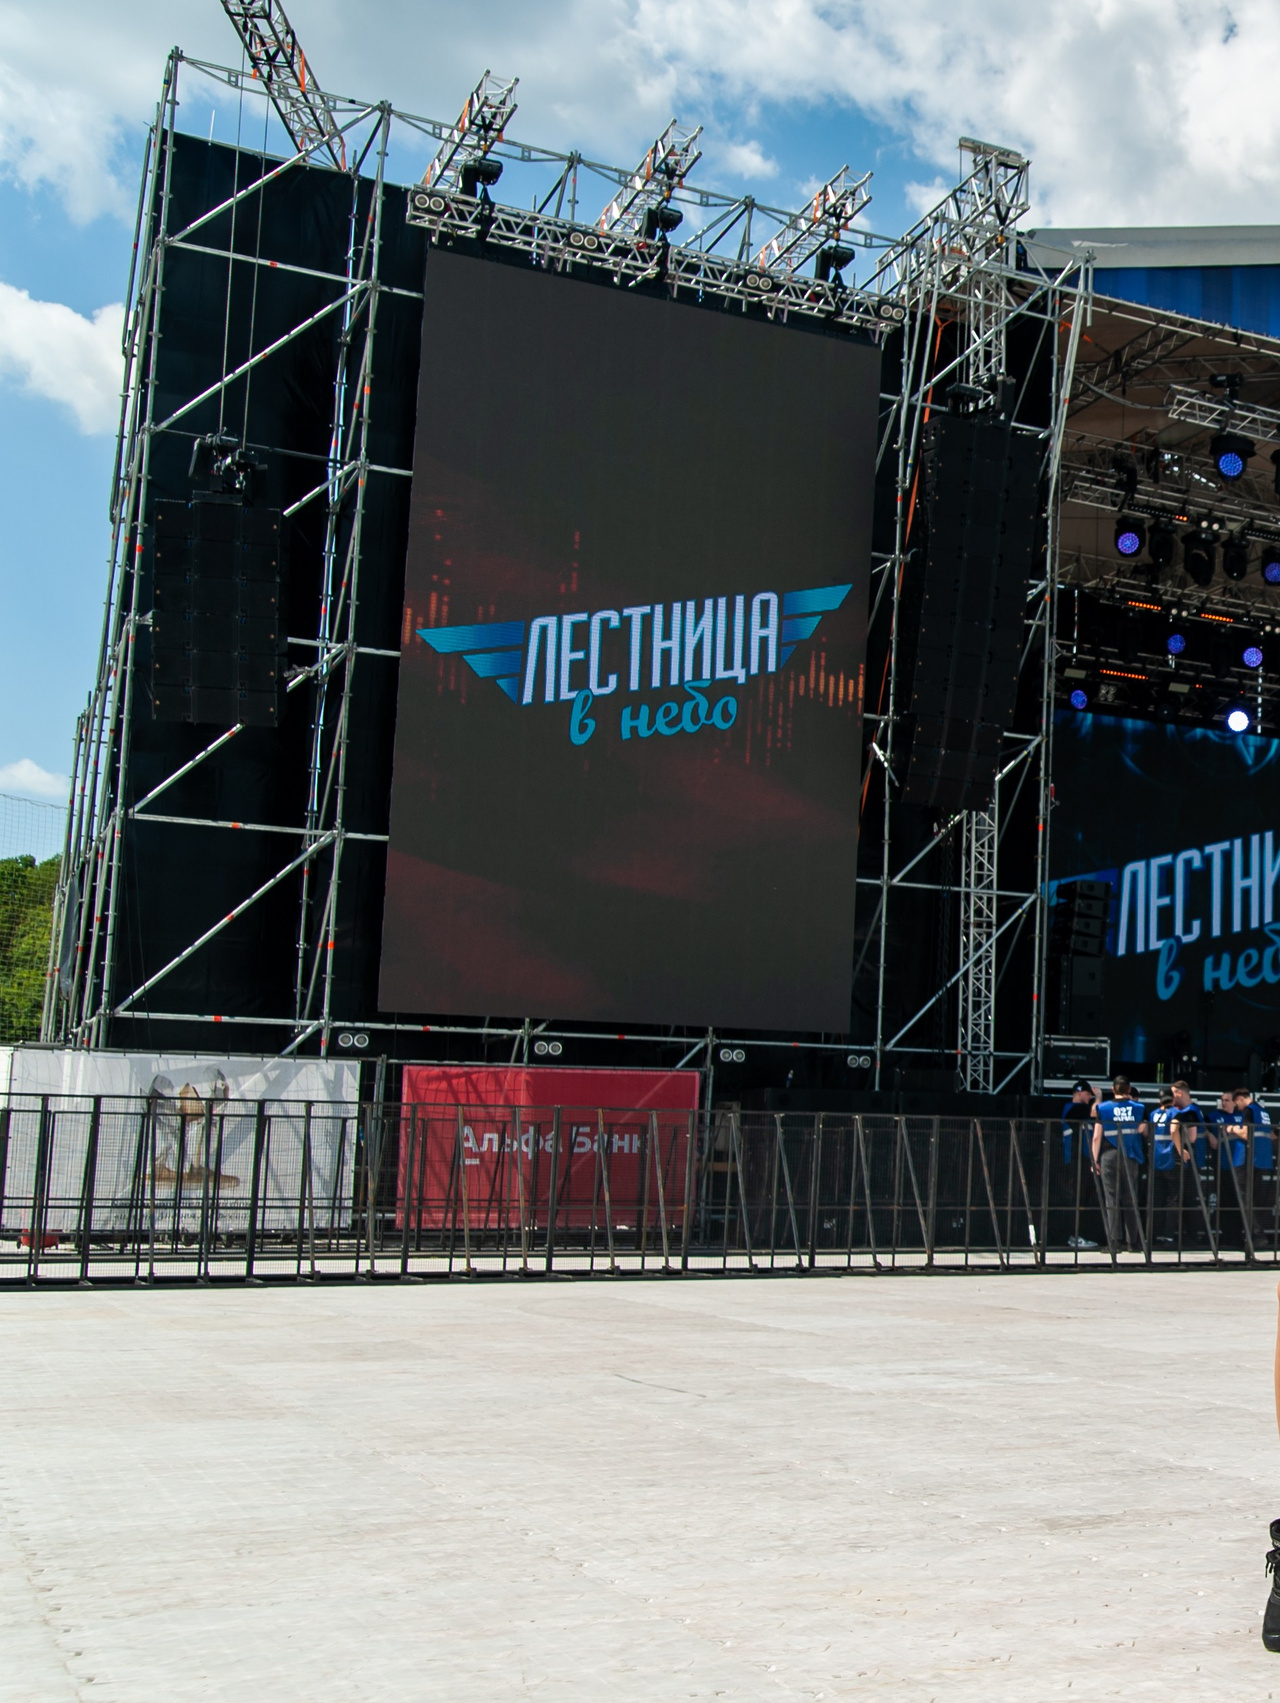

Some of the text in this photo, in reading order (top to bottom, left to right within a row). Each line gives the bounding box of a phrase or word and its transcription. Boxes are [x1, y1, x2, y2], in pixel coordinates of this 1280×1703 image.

[521, 591, 779, 706] ЛЕСТНИЦА
[569, 679, 738, 746] в небо
[1156, 936, 1183, 1001] в
